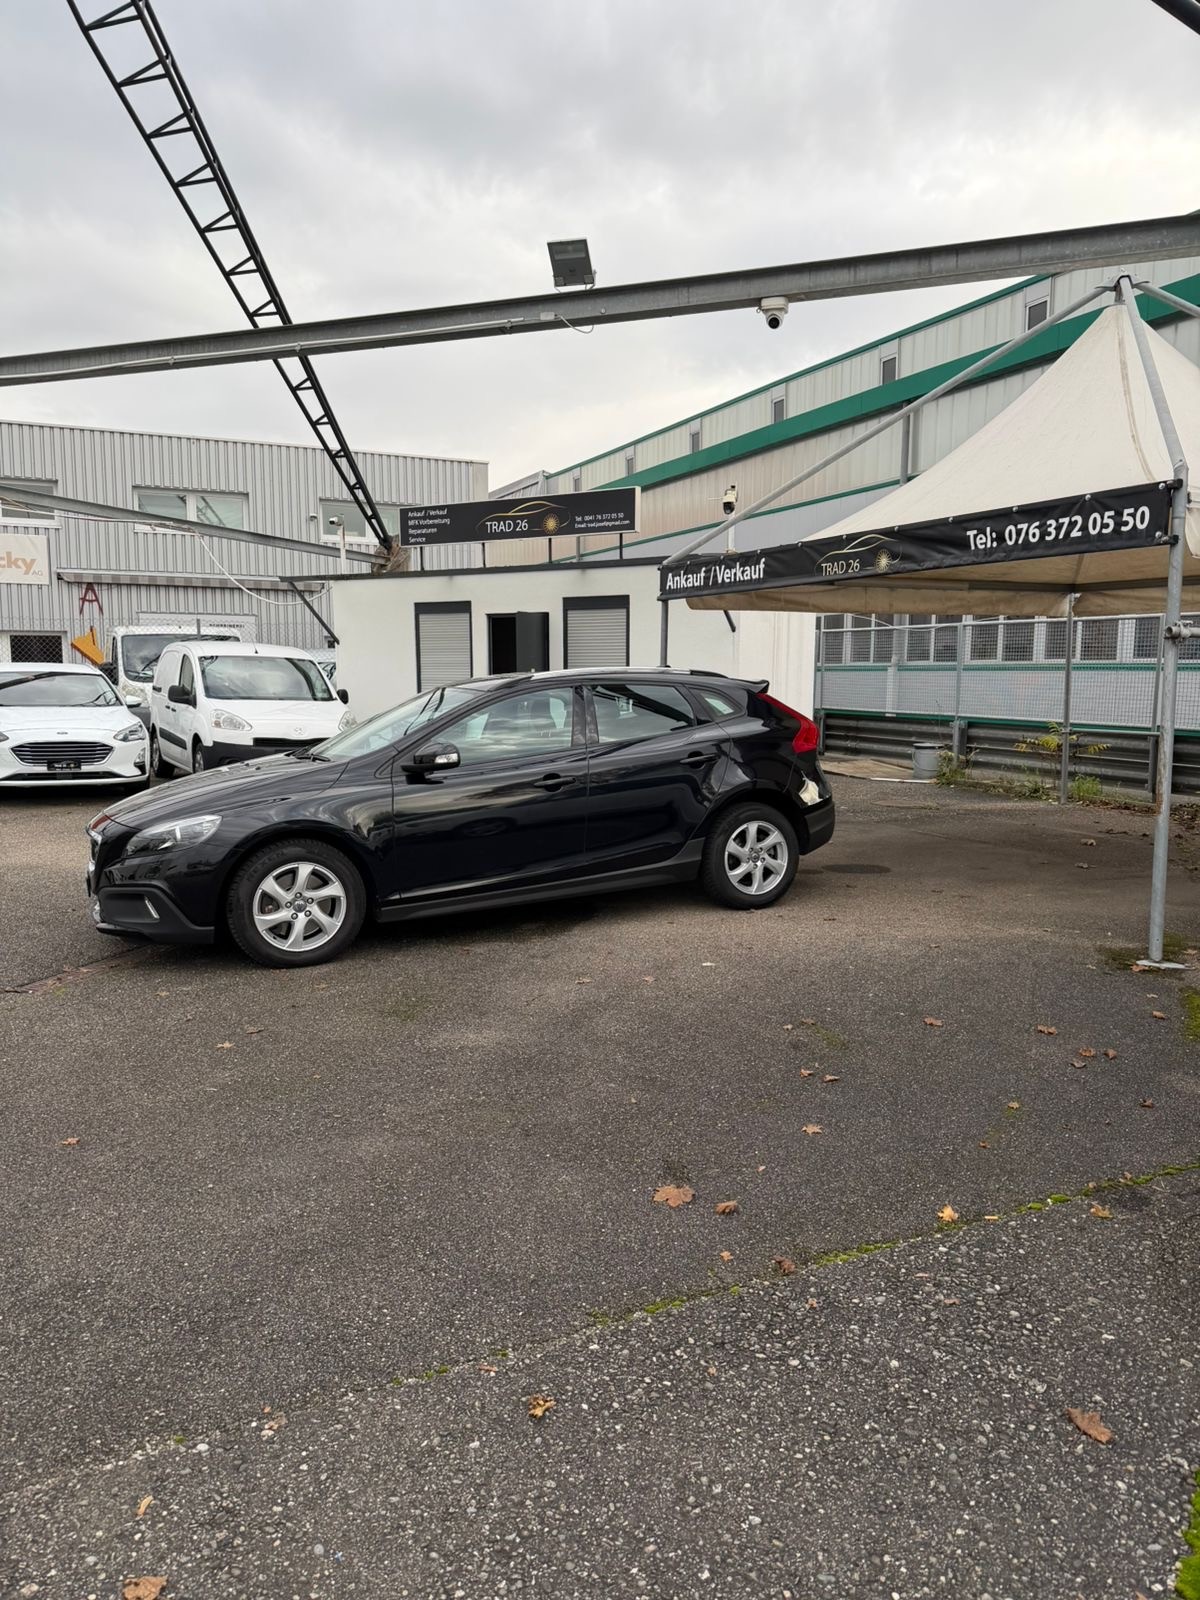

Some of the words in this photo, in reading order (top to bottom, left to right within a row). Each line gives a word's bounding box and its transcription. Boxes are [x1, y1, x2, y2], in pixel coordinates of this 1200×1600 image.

[408, 528, 438, 536] Reparaturen
[485, 520, 514, 534] TRAD
[515, 519, 529, 532] 26
[966, 526, 997, 551] Tel:
[1004, 521, 1041, 546] 076
[1045, 515, 1083, 541] 372
[1088, 510, 1115, 535] 05
[1120, 505, 1151, 532] 50
[31, 569, 44, 577] AG
[821, 560, 846, 577] TRAD
[848, 558, 861, 573] 26
[666, 567, 706, 590] Ankauf
